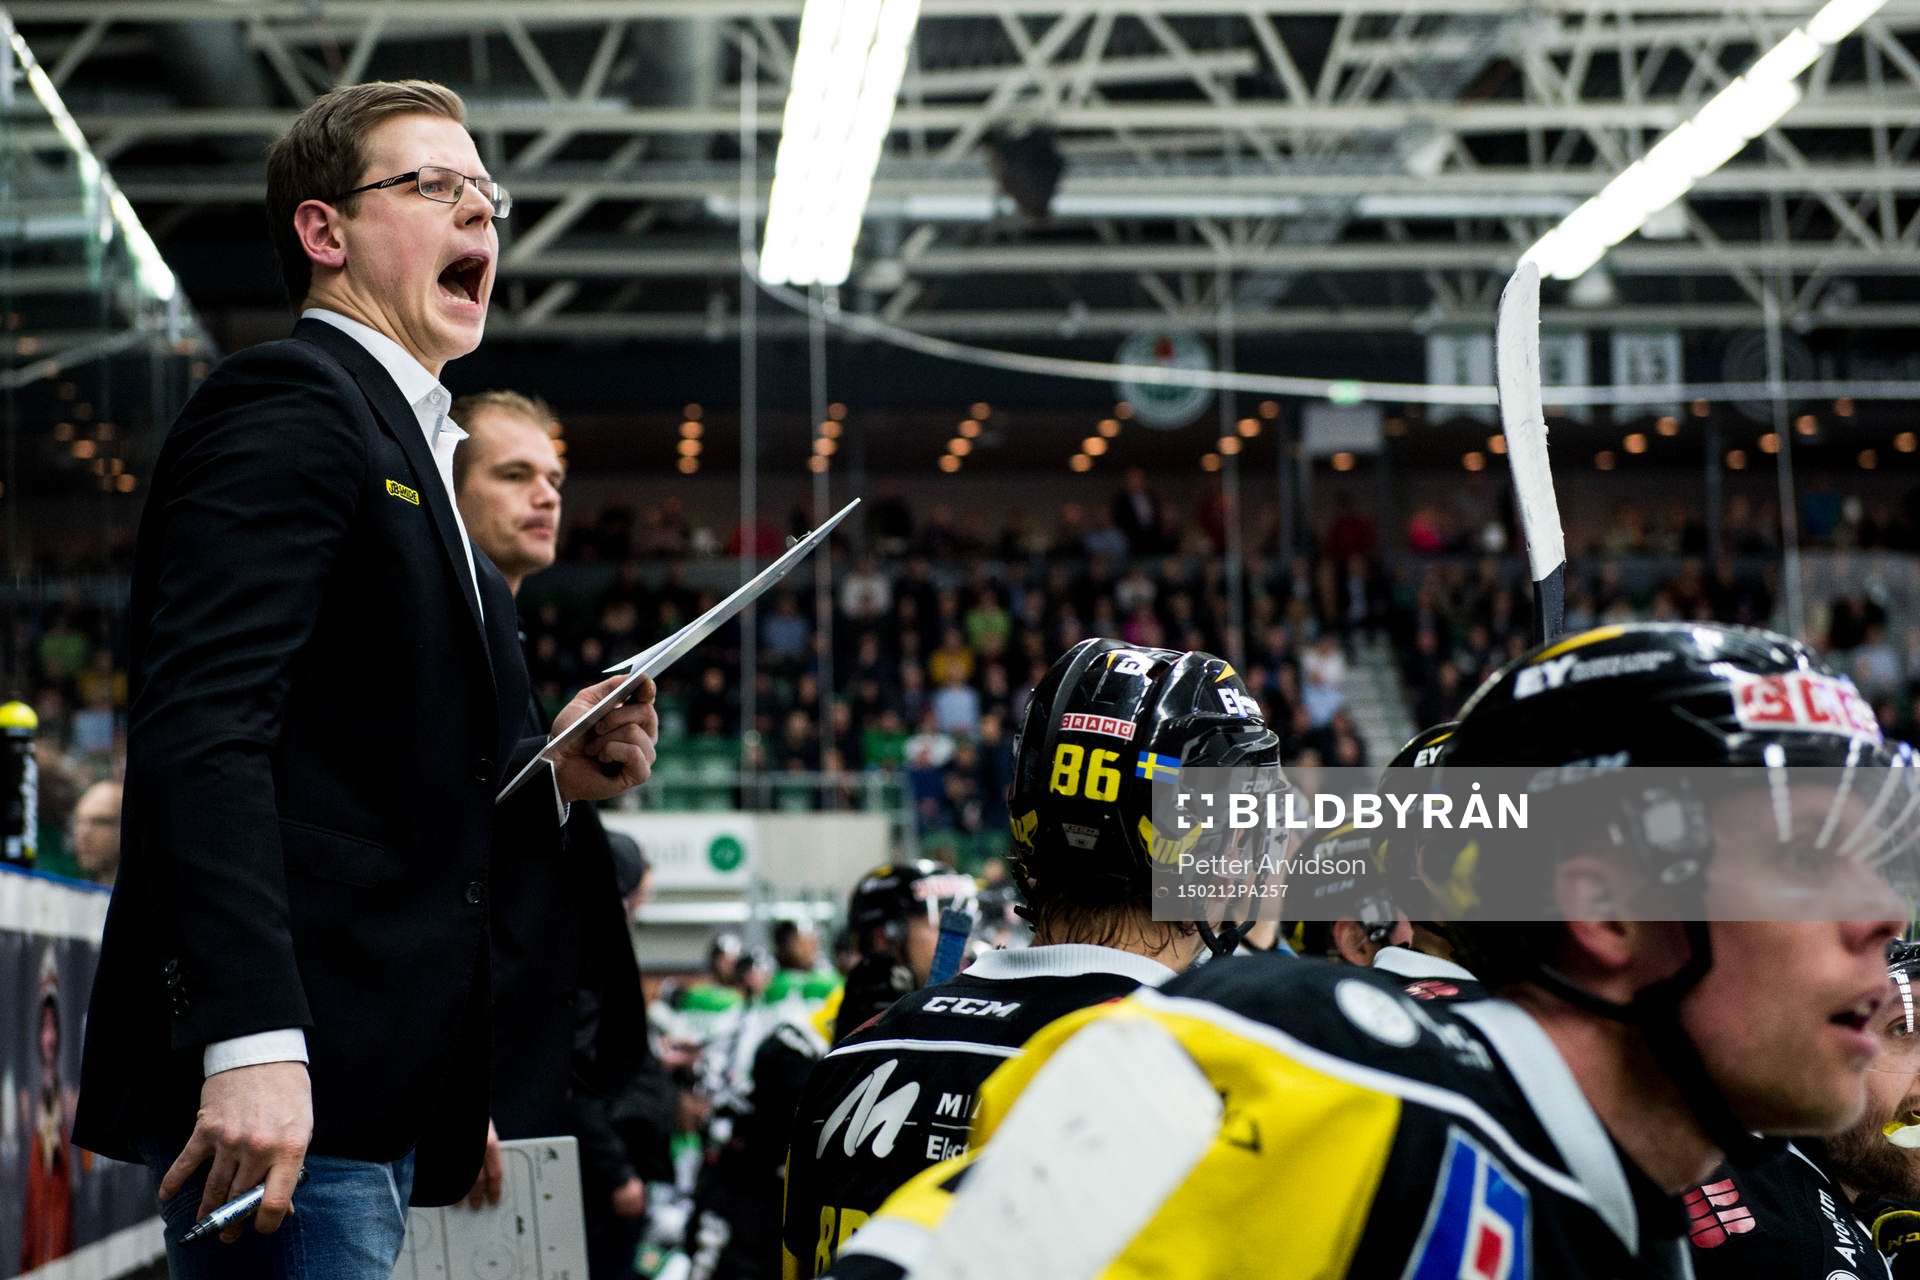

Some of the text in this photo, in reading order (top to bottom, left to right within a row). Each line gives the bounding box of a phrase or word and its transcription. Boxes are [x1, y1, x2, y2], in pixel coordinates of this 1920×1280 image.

[1414, 744, 1445, 768] EY
[1050, 743, 1121, 802] 86
[922, 996, 1021, 1018] CCM
